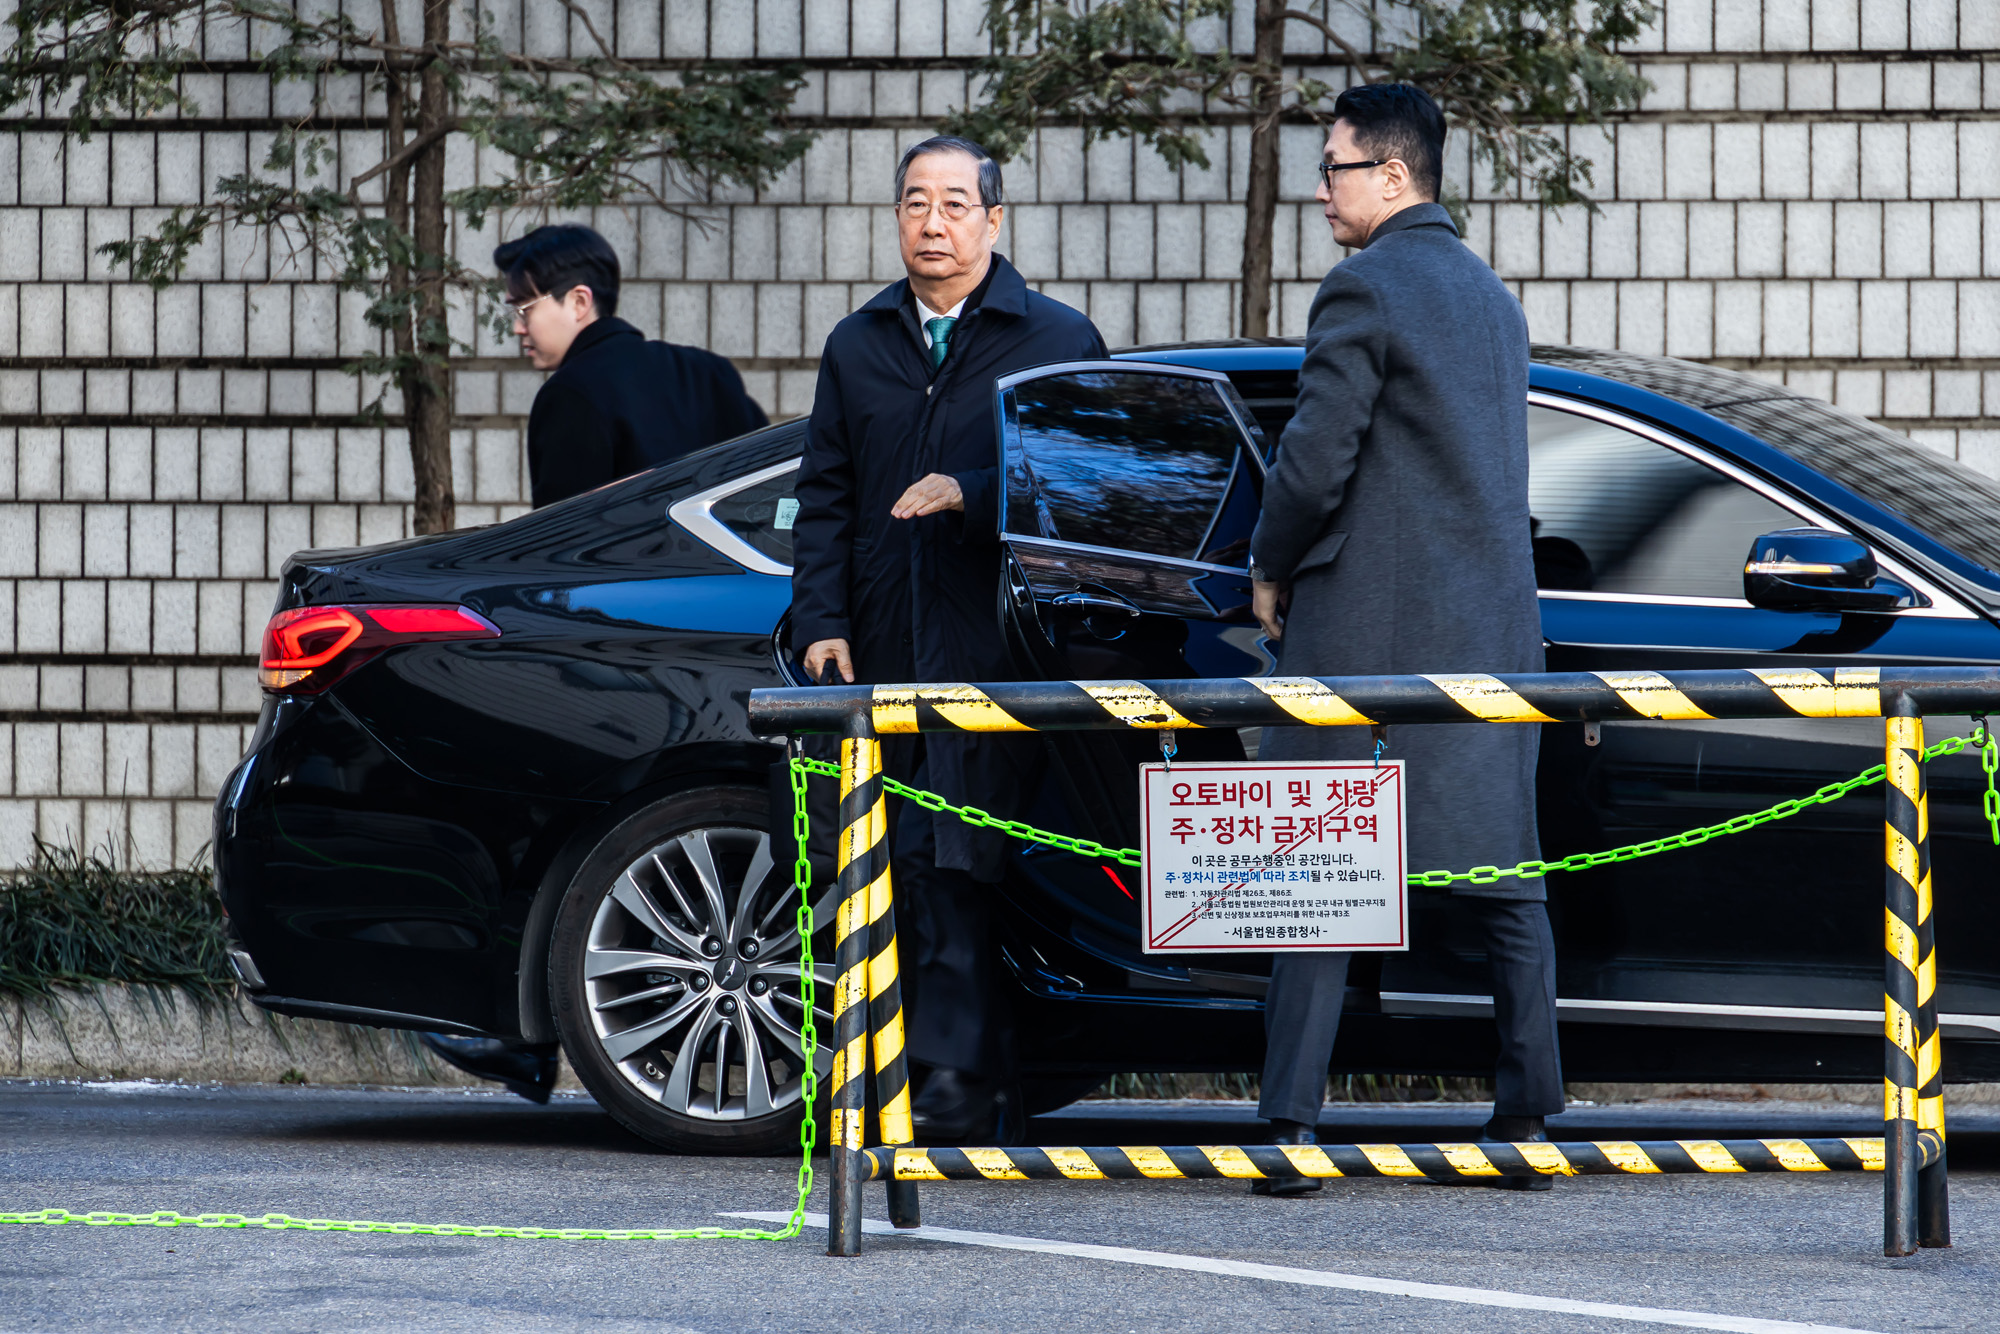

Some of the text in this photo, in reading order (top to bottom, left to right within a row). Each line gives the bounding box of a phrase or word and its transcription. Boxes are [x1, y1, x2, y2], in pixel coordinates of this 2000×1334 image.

[1169, 778, 1379, 809] 오토바이 및 차량
[1169, 814, 1378, 845] 주·정차 금지구역
[1192, 853, 1358, 867] 이 곳은 공무수행중인 공간입니다.
[1165, 869, 1385, 884] 주·정차시 관련법에 따라 조치될 수 있습니다.
[1164, 889, 1292, 898] 관련법: 1. 자동차관리법 제26조, 제86조
[1200, 900, 1241, 908] 서울고등법원
[1243, 900, 1290, 908] 법원보안관리대
[1315, 899, 1329, 907] 근무
[1330, 899, 1343, 907] 내규
[1200, 911, 1214, 919] 신변
[1215, 911, 1222, 919] 및
[1224, 911, 1251, 919] 신상정보
[1301, 910, 1315, 918] 위한
[1316, 910, 1330, 918] 내규
[1332, 910, 1350, 918] 제3조
[1231, 925, 1320, 938] 서울법원종합청사
